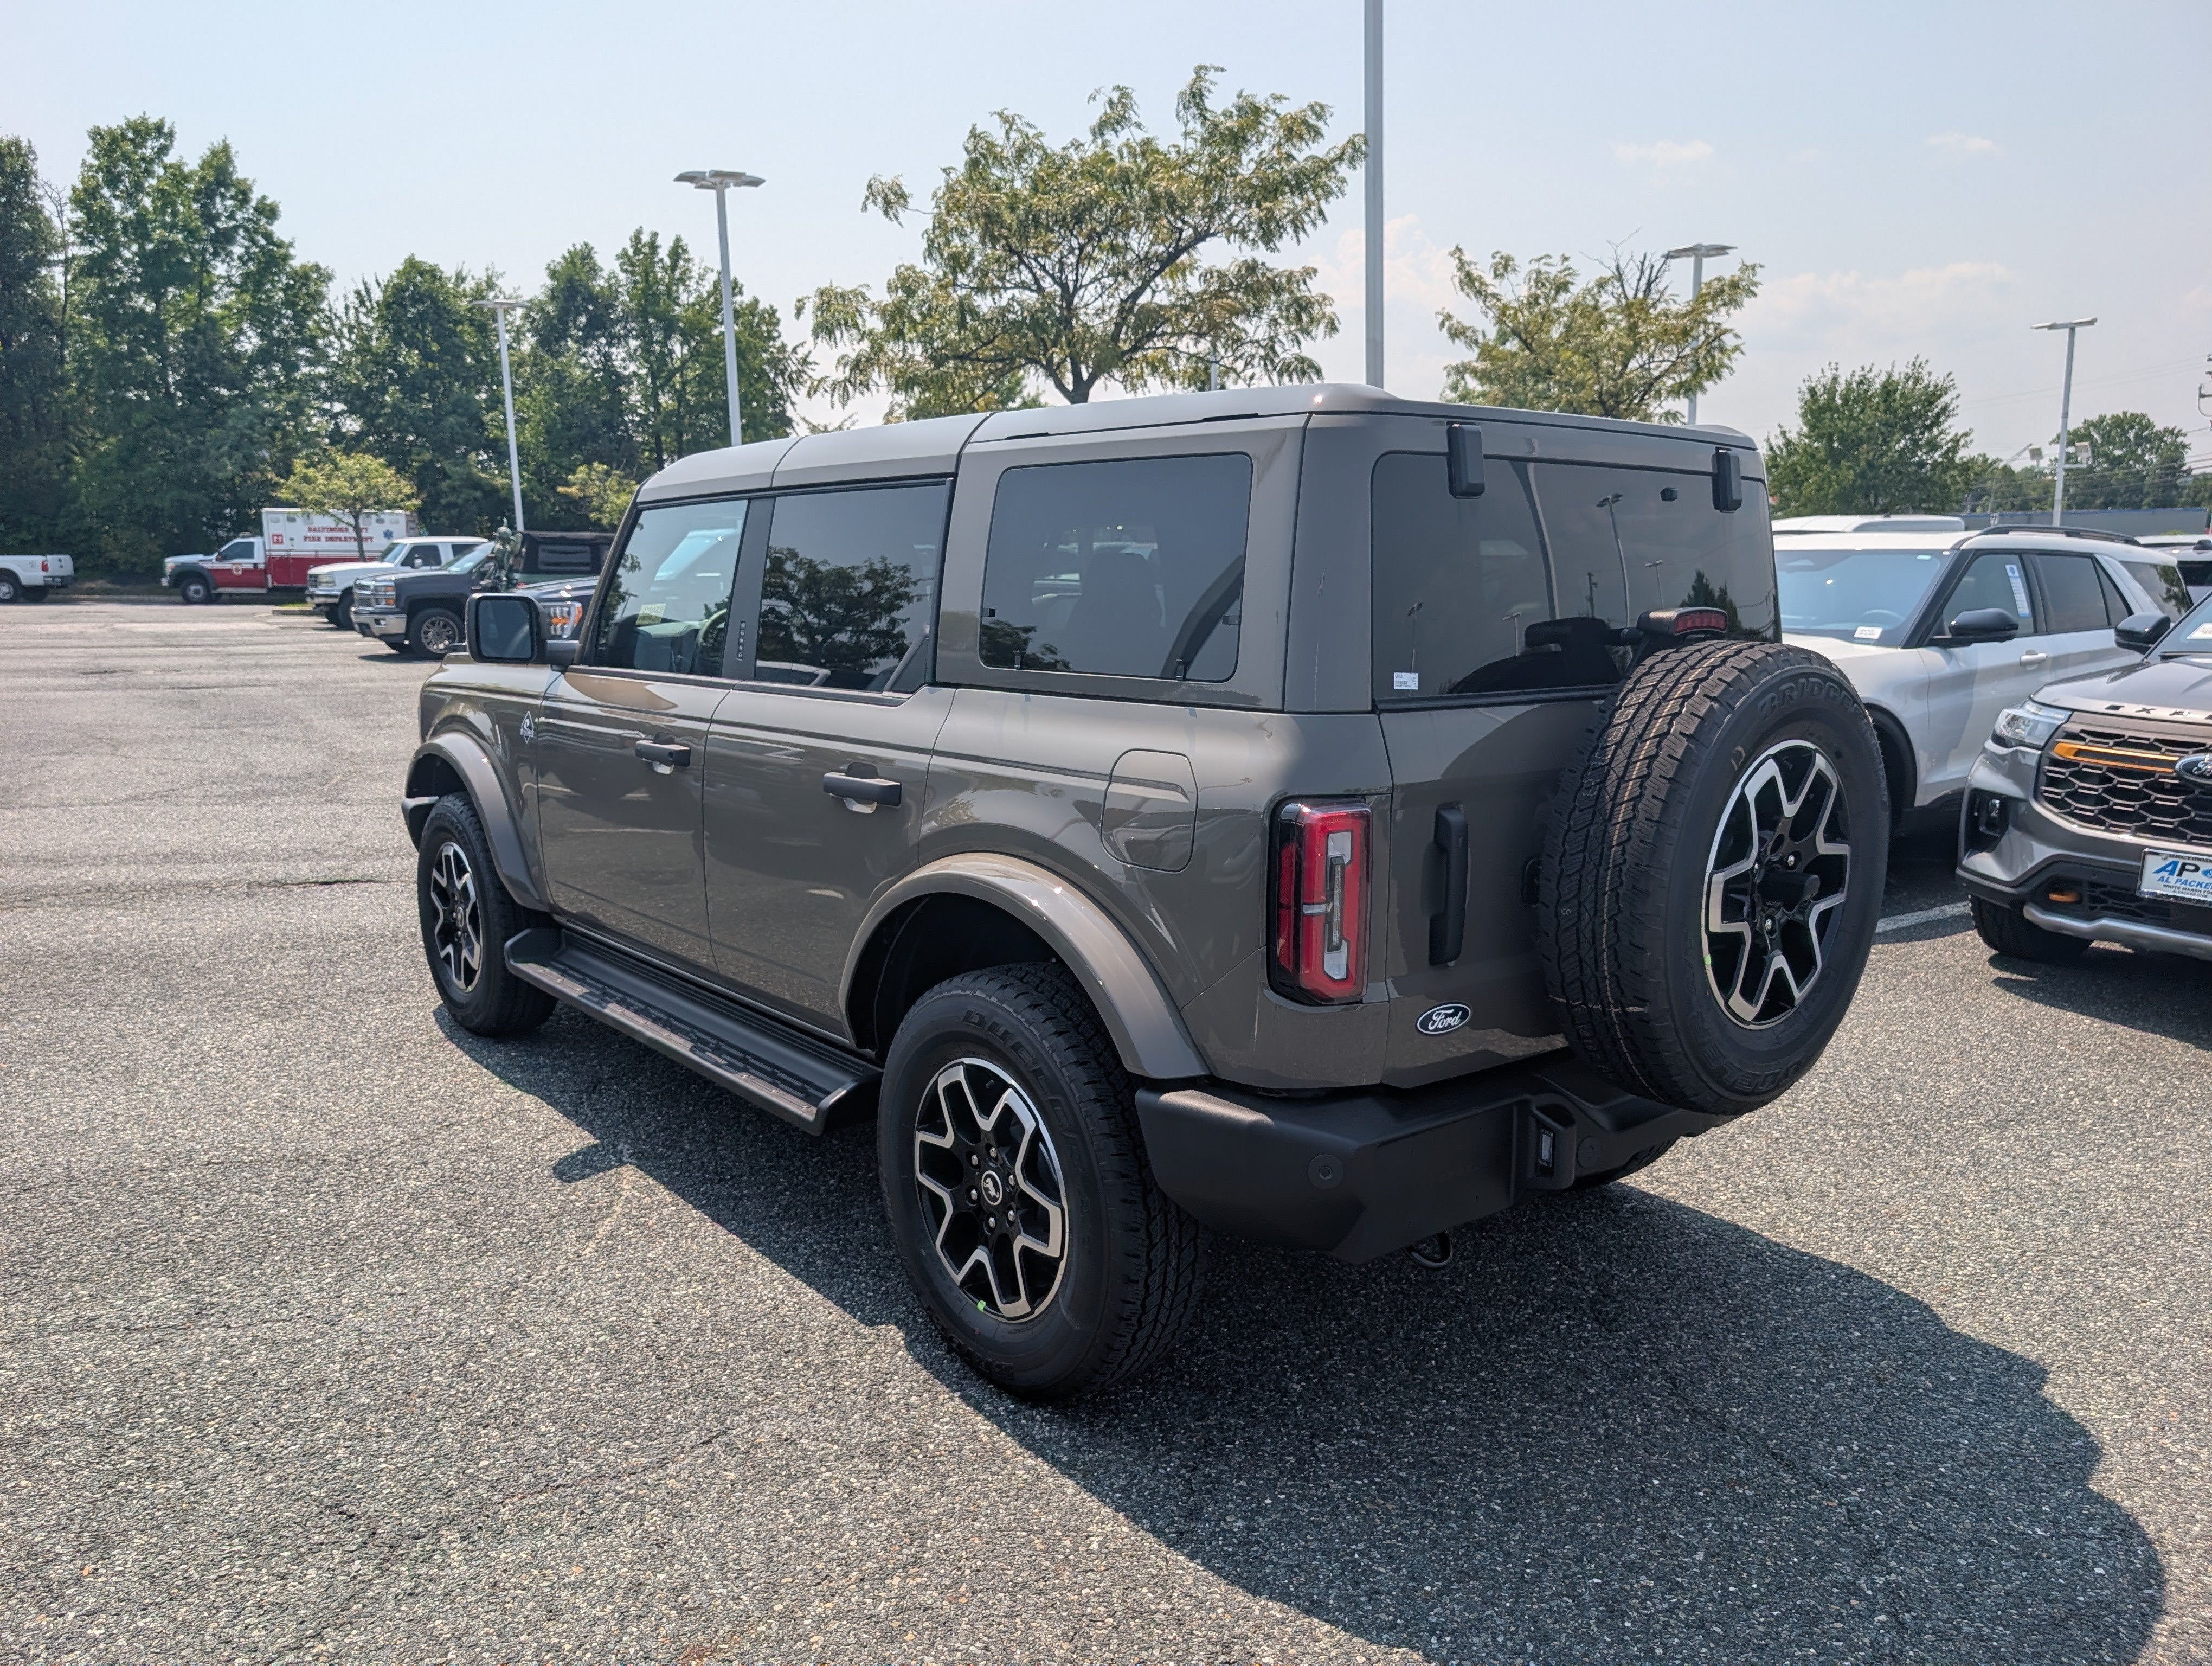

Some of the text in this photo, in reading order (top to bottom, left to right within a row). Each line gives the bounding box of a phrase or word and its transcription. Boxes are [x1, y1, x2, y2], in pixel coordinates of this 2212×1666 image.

[2152, 860, 2200, 877] AP
[2175, 877, 2212, 889] PACKE
[1428, 1008, 1462, 1030] Ford
